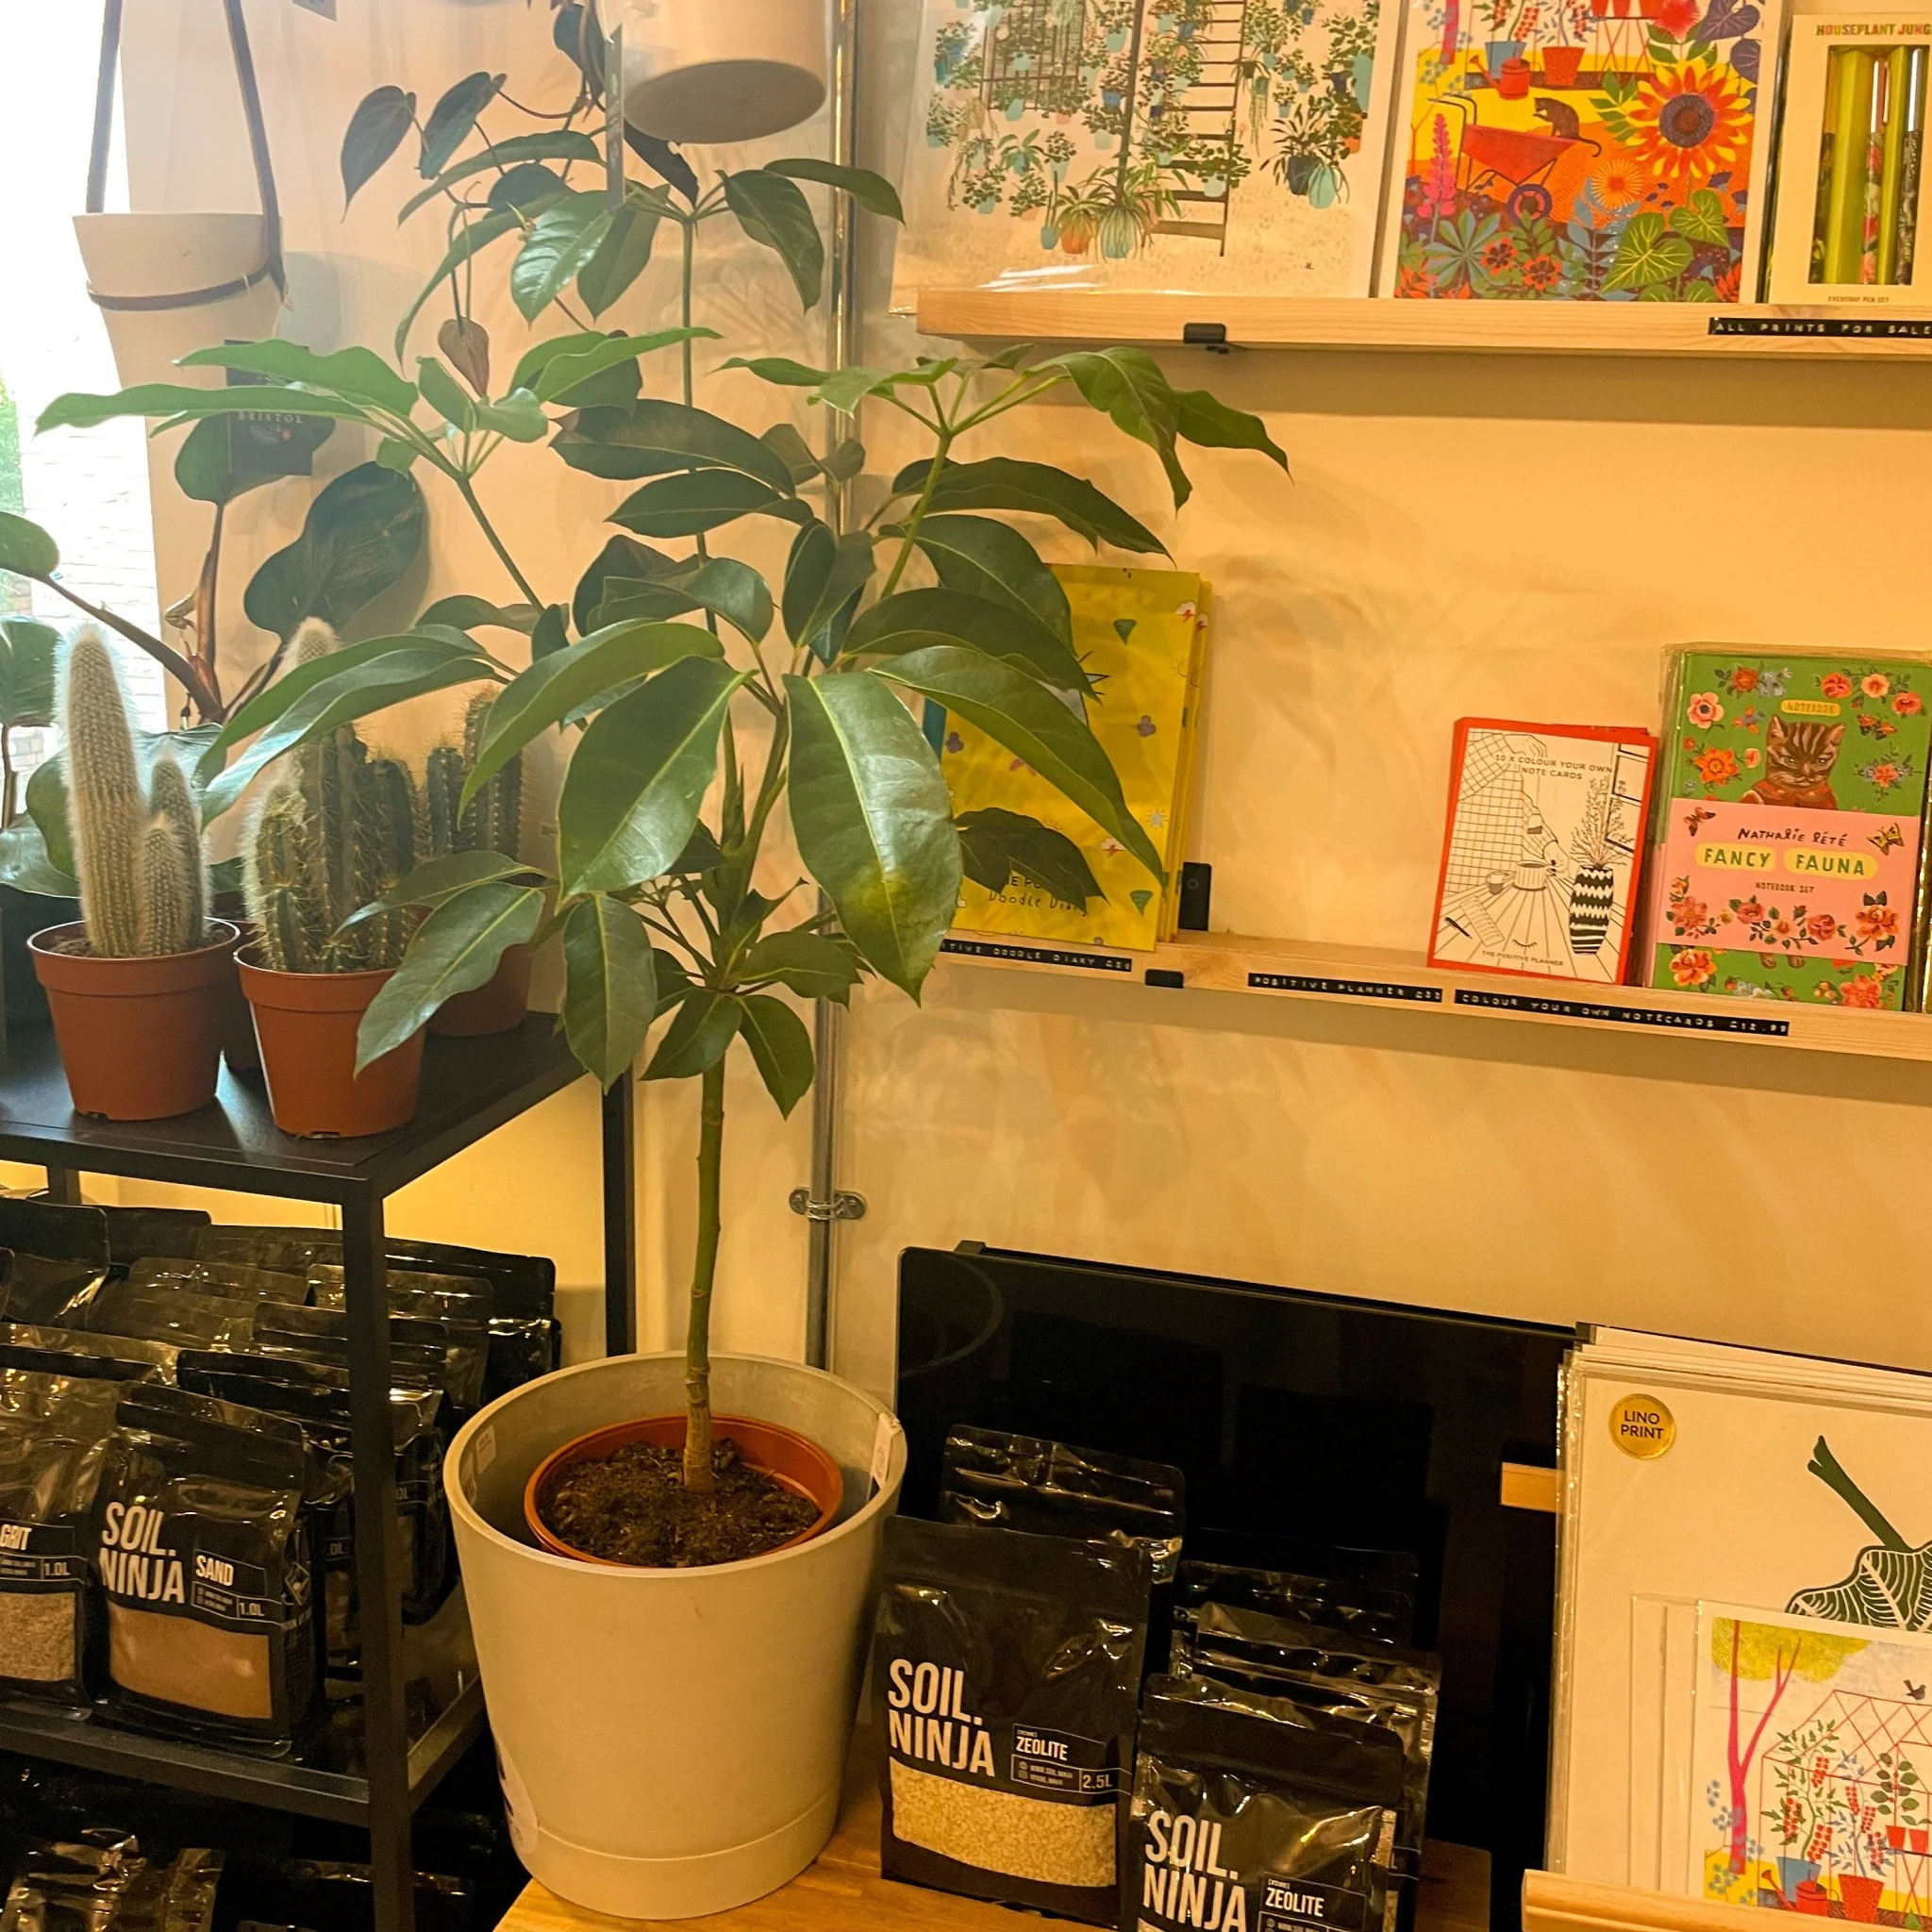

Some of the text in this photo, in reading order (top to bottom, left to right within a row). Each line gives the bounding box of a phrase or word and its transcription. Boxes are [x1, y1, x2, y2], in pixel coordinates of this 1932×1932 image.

[1816, 23, 1932, 36] HOUSEPLANT JUNG
[1716, 324, 1932, 334] ALL PRINTS FOR SALE
[238, 411, 304, 424] BRISTOL
[1518, 757, 1557, 767] COLOUR
[1560, 761, 1586, 770] YOUR
[1589, 764, 1612, 773] OWN
[1522, 767, 1583, 780] NOTE CARDS
[1705, 848, 1864, 875] FANCY FAUNA
[1756, 882, 1794, 892] NOTEBOOK
[1054, 953, 1095, 964] DIARY
[1531, 958, 1563, 966] PLANNER
[1255, 976, 1327, 990] POSITIVE
[1338, 983, 1404, 996] PLANNER
[1462, 994, 1518, 1007] COLOUR
[1531, 1002, 1571, 1013] YOUR
[1582, 1007, 1610, 1017] OWN
[1622, 1011, 1714, 1028] NOTECARDS
[1624, 1409, 1660, 1424] LINO
[1621, 1424, 1664, 1440] PRINT
[0, 1524, 33, 1551] GRIT
[102, 1501, 176, 1557] SOIL.
[99, 1547, 185, 1604] NINJA
[195, 1555, 234, 1587] SAND
[888, 1658, 983, 1726] SOIL.
[889, 1708, 995, 1777] NINJA
[1016, 1736, 1069, 1761] ZEOLITE
[1082, 1774, 1113, 1790] 2.5L
[1145, 1809, 1239, 1880] SOIL.
[1143, 1862, 1247, 1932] NINJA
[1265, 1887, 1324, 1917] ZEOLITE
